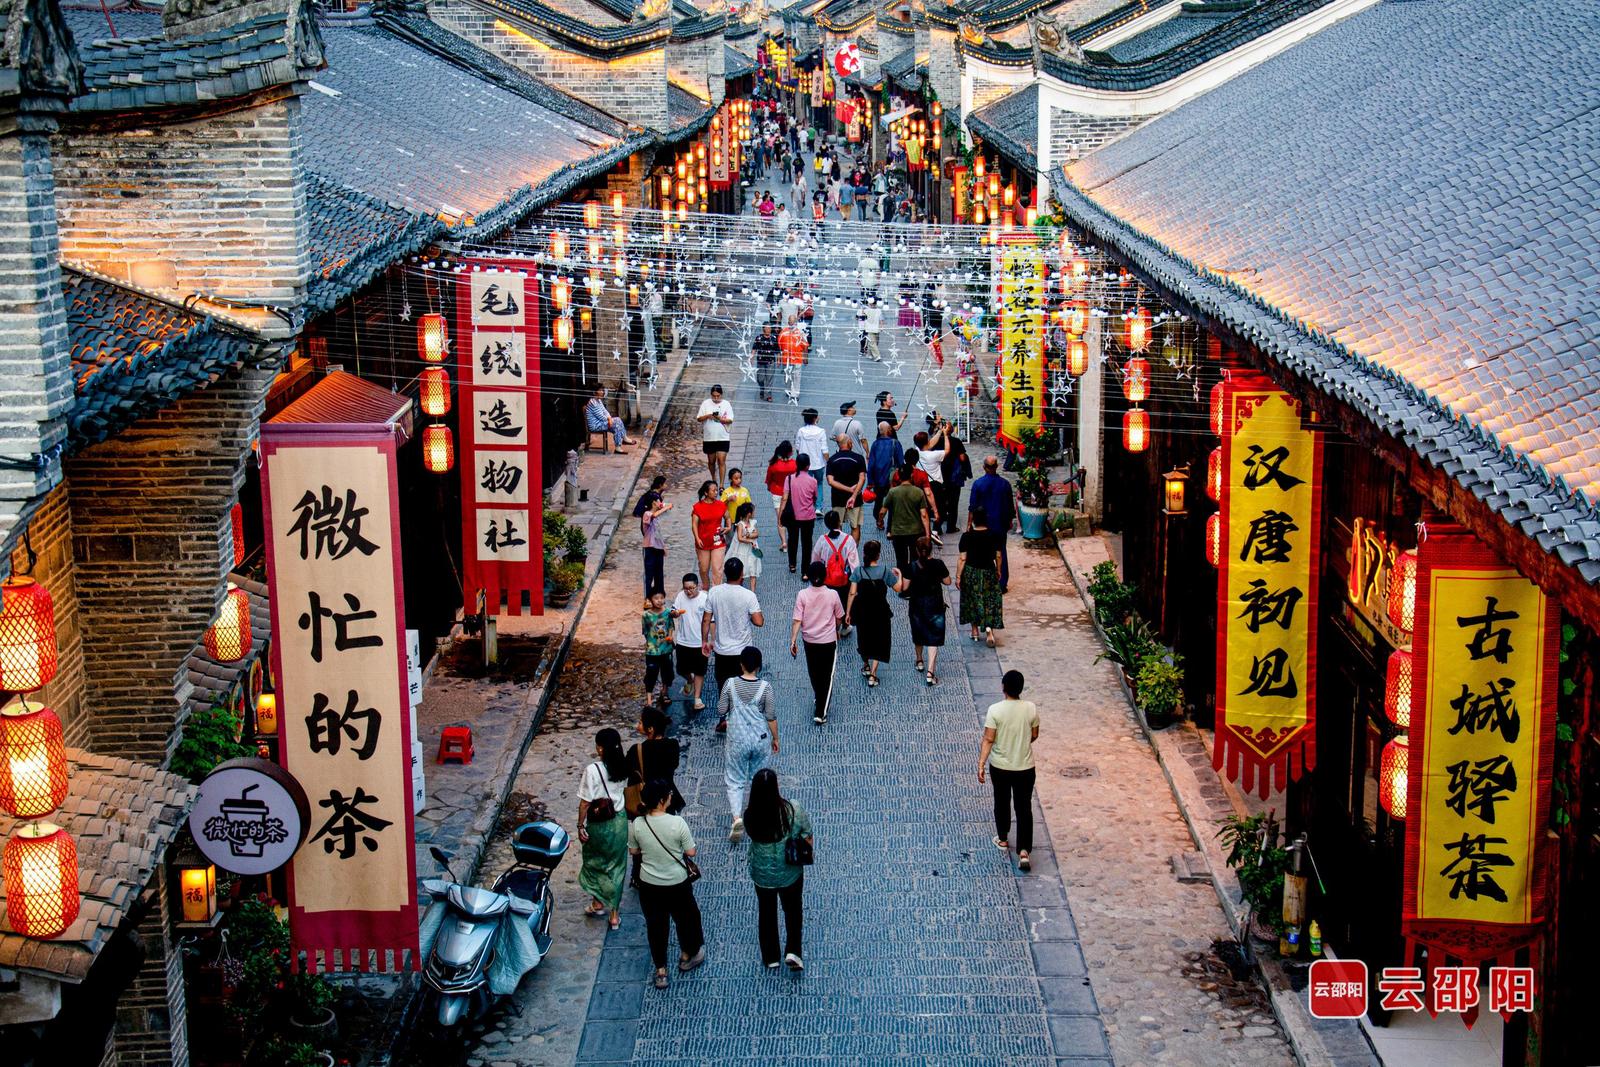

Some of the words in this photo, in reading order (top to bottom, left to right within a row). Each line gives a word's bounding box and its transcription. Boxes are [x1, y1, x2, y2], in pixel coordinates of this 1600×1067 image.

[479, 283, 526, 553] 毛线造物社
[286, 485, 394, 860] 微忙的茶
[1235, 444, 1307, 698] 汉唐初见
[203, 818, 288, 844] 微忙的茶
[1440, 596, 1521, 902] 古城驿茶
[185, 887, 204, 903] 福
